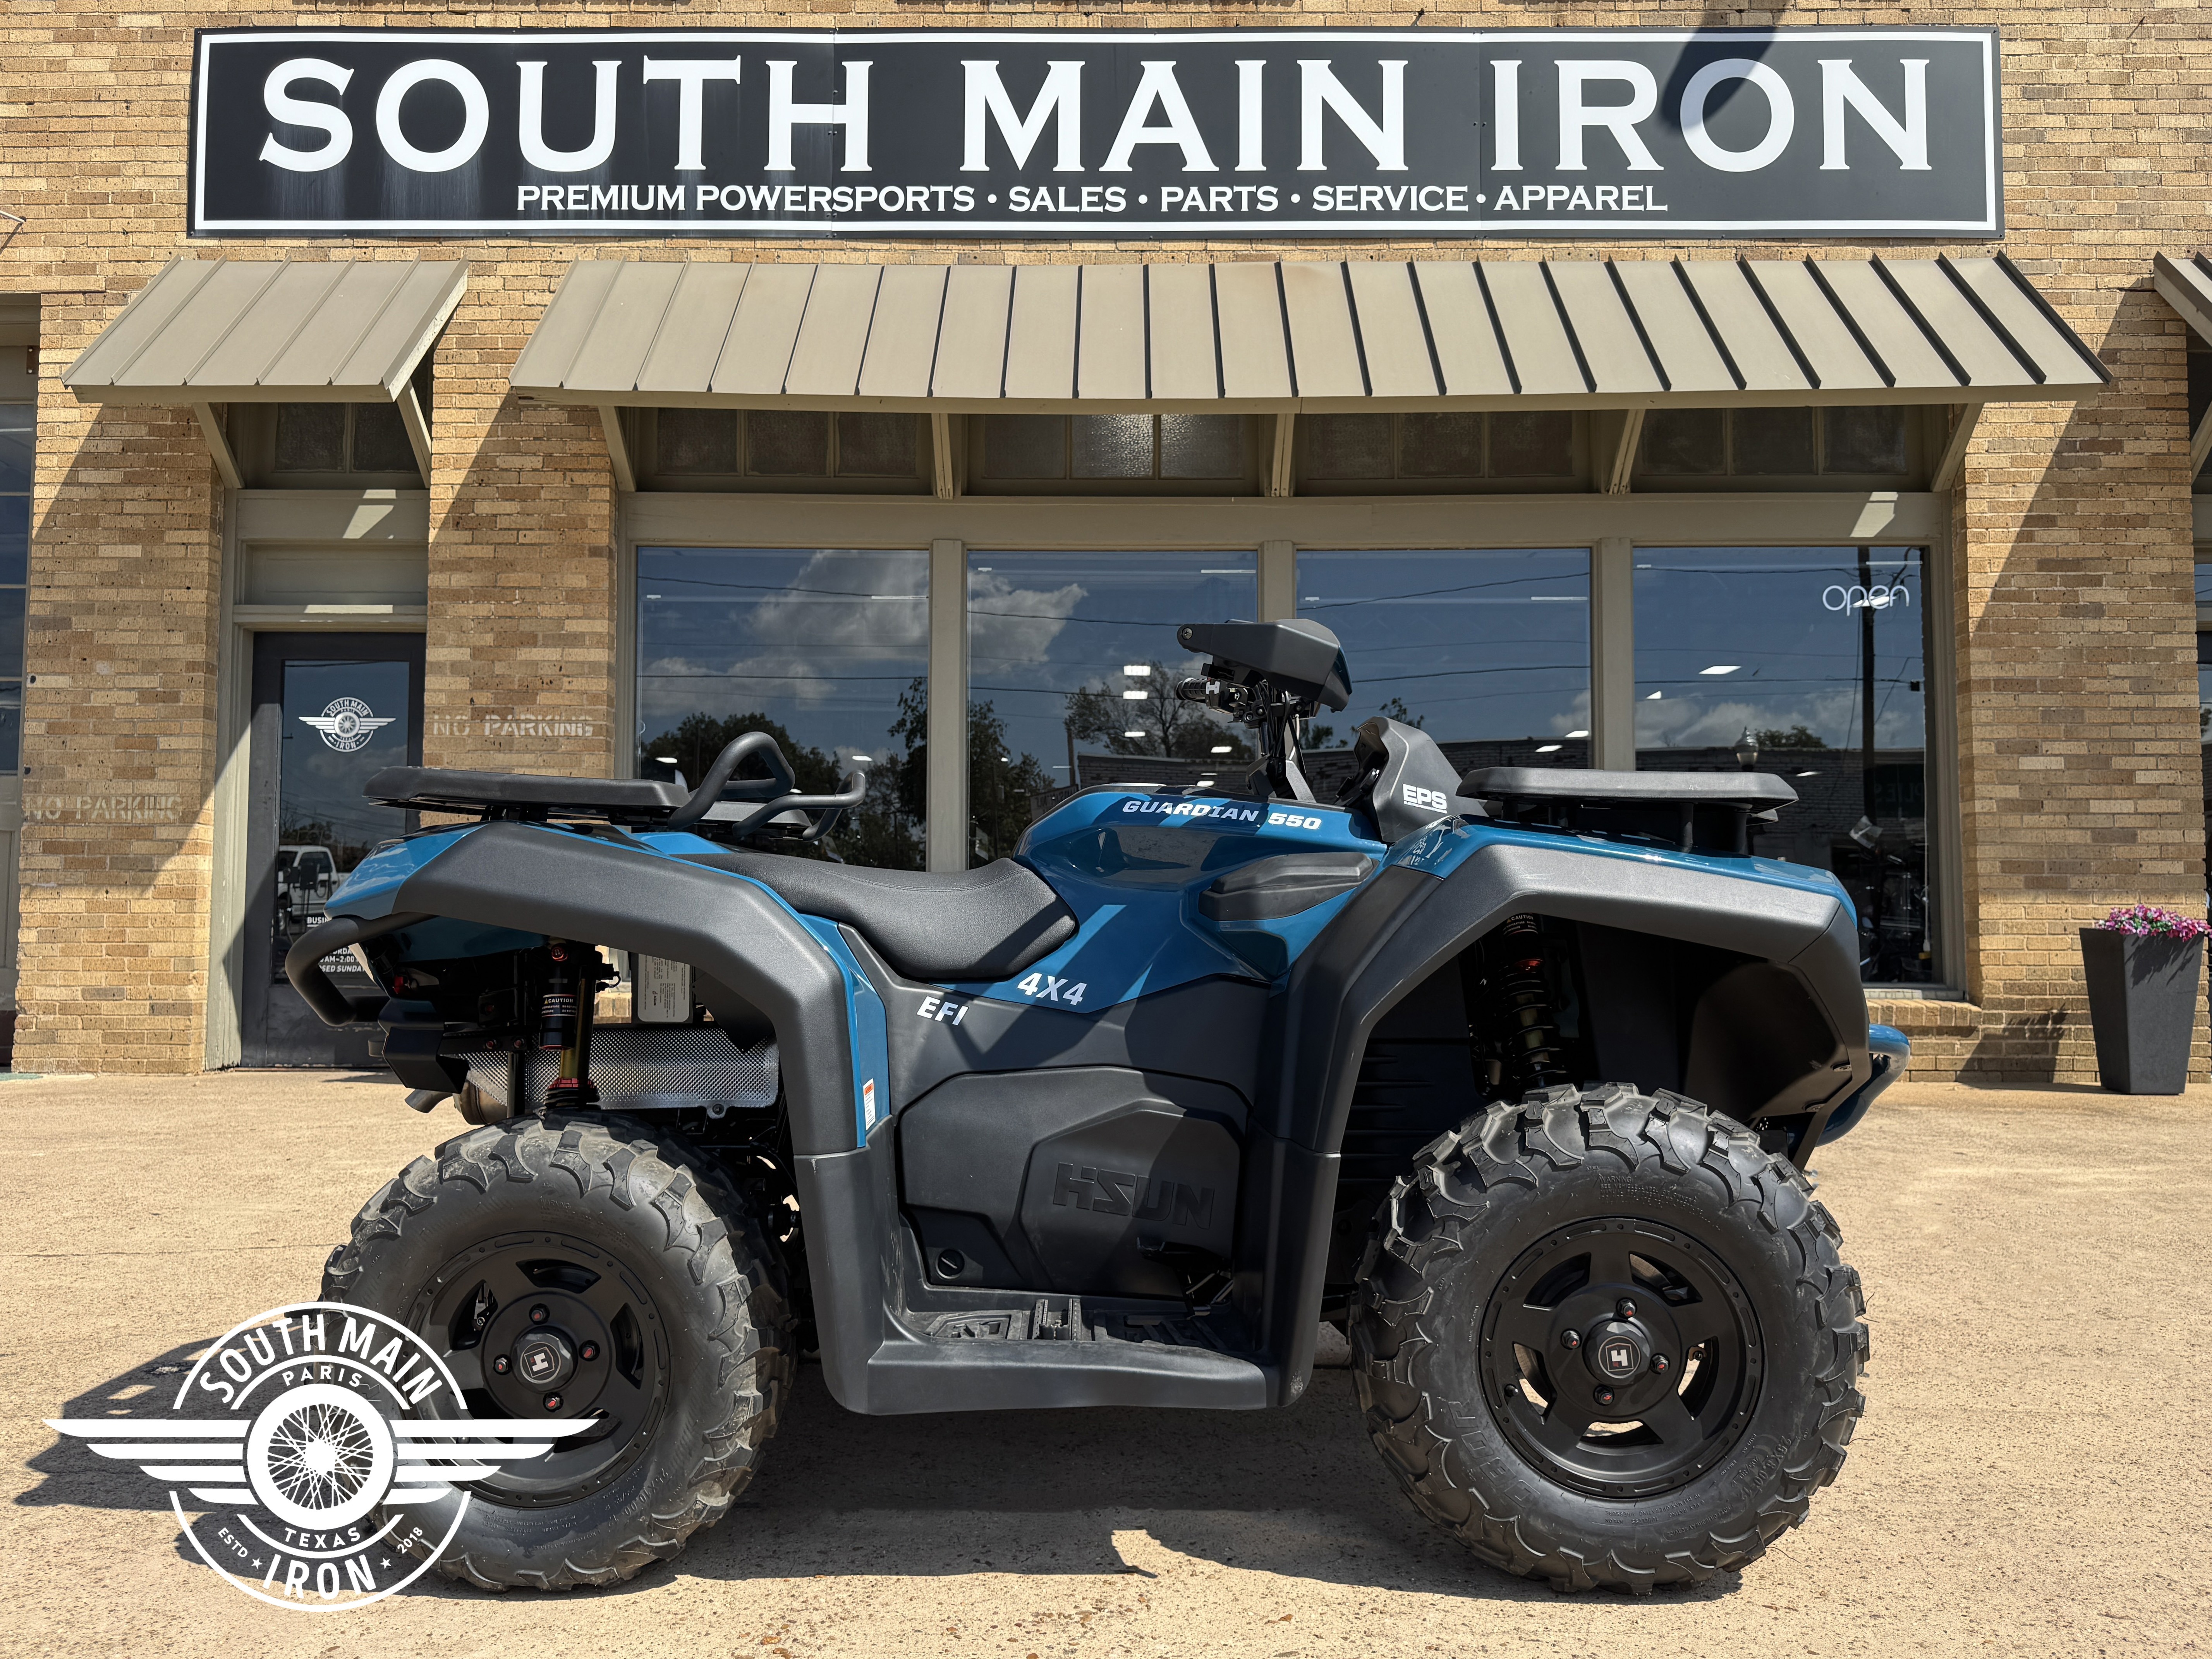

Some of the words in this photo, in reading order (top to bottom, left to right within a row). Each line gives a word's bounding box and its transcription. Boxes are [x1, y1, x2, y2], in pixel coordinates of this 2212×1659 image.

[259, 55, 873, 172] SOUTH
[960, 60, 1408, 171] MAIN
[1490, 59, 1932, 172] IRON
[517, 184, 685, 211] PREMIUM
[697, 185, 974, 212] POWERSPORTS
[1009, 186, 1126, 212] SALES
[1161, 185, 1278, 212] PARTS
[1312, 185, 1468, 211] SERVICE
[1494, 185, 1668, 211] APPAREL
[1822, 585, 1910, 616] open
[326, 699, 349, 716] SOUTH
[351, 701, 369, 716] MAIN
[433, 714, 470, 735] NO
[484, 714, 594, 737] PARKING
[336, 741, 356, 750] IRON
[24, 796, 61, 820] NO
[76, 796, 181, 820] PARKING
[1403, 783, 1447, 810] EPS
[1122, 800, 1259, 822] GUARDIAN
[1267, 812, 1322, 830] 550
[1017, 972, 1087, 1006] 4X4
[916, 996, 969, 1025] EFI
